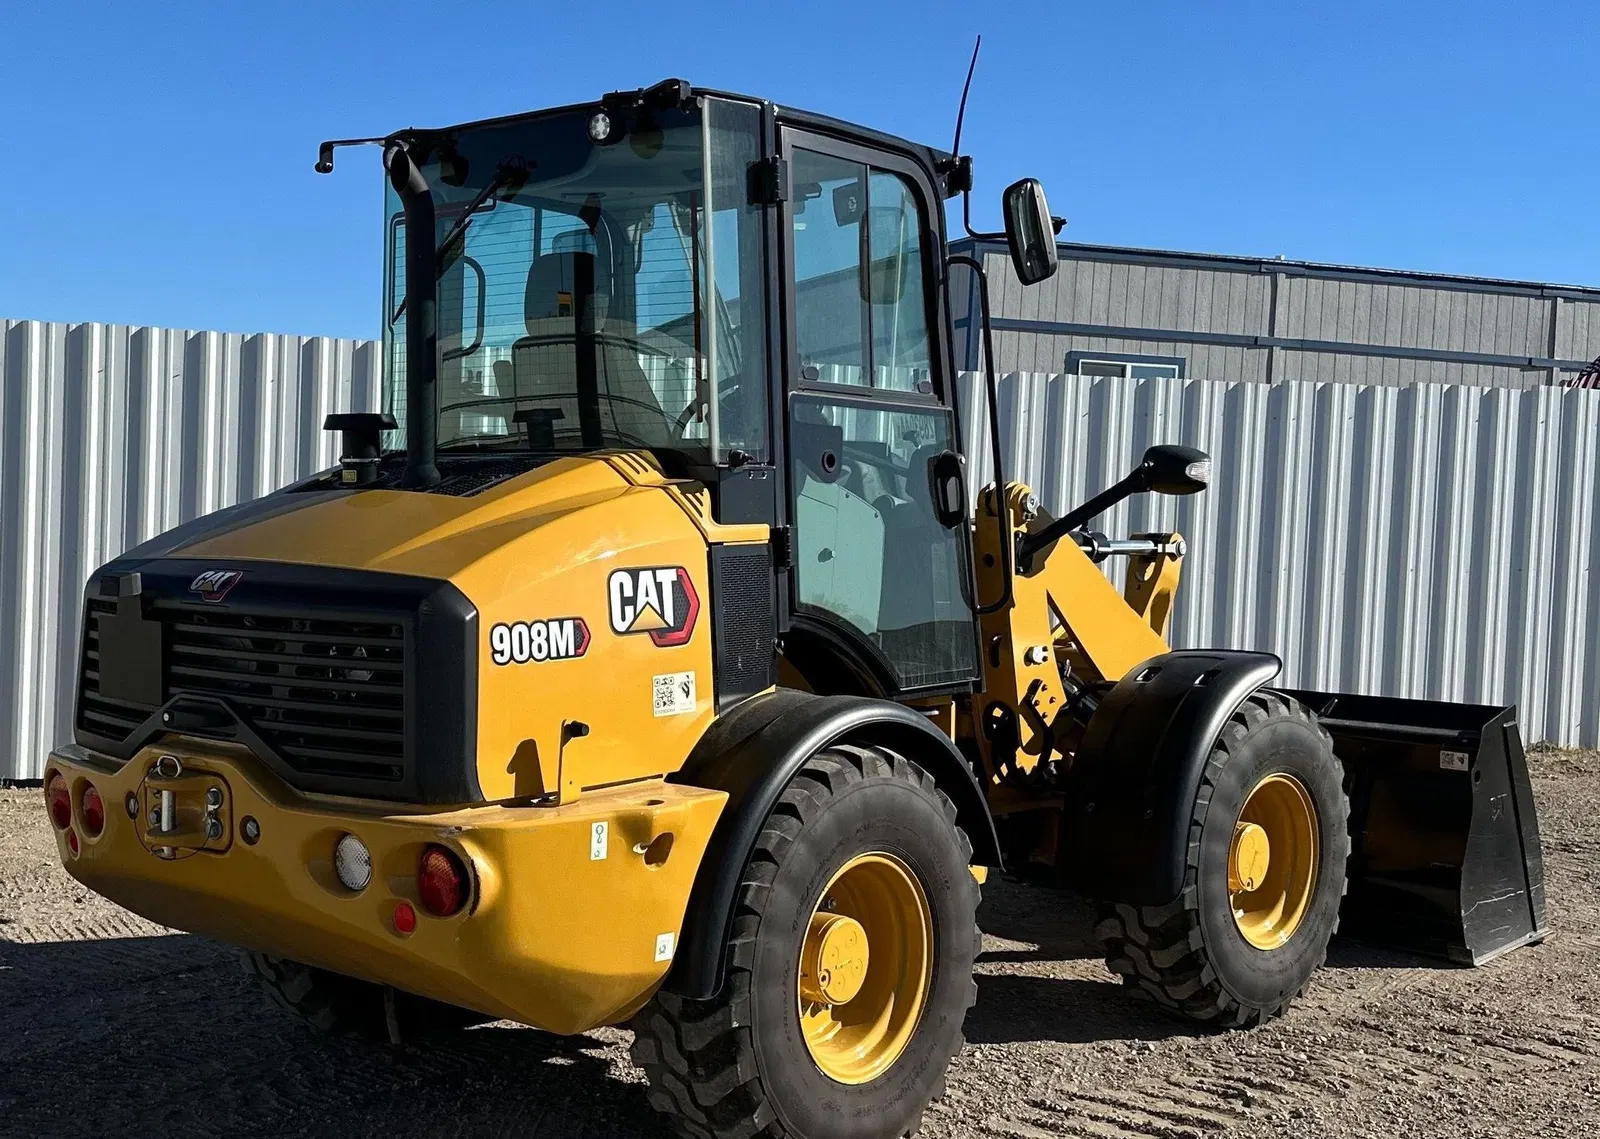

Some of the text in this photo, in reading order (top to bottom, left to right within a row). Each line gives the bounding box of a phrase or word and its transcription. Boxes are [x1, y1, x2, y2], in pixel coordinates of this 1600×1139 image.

[190, 571, 237, 591] CAT
[609, 568, 678, 632] CAT
[491, 619, 576, 664] 908M
